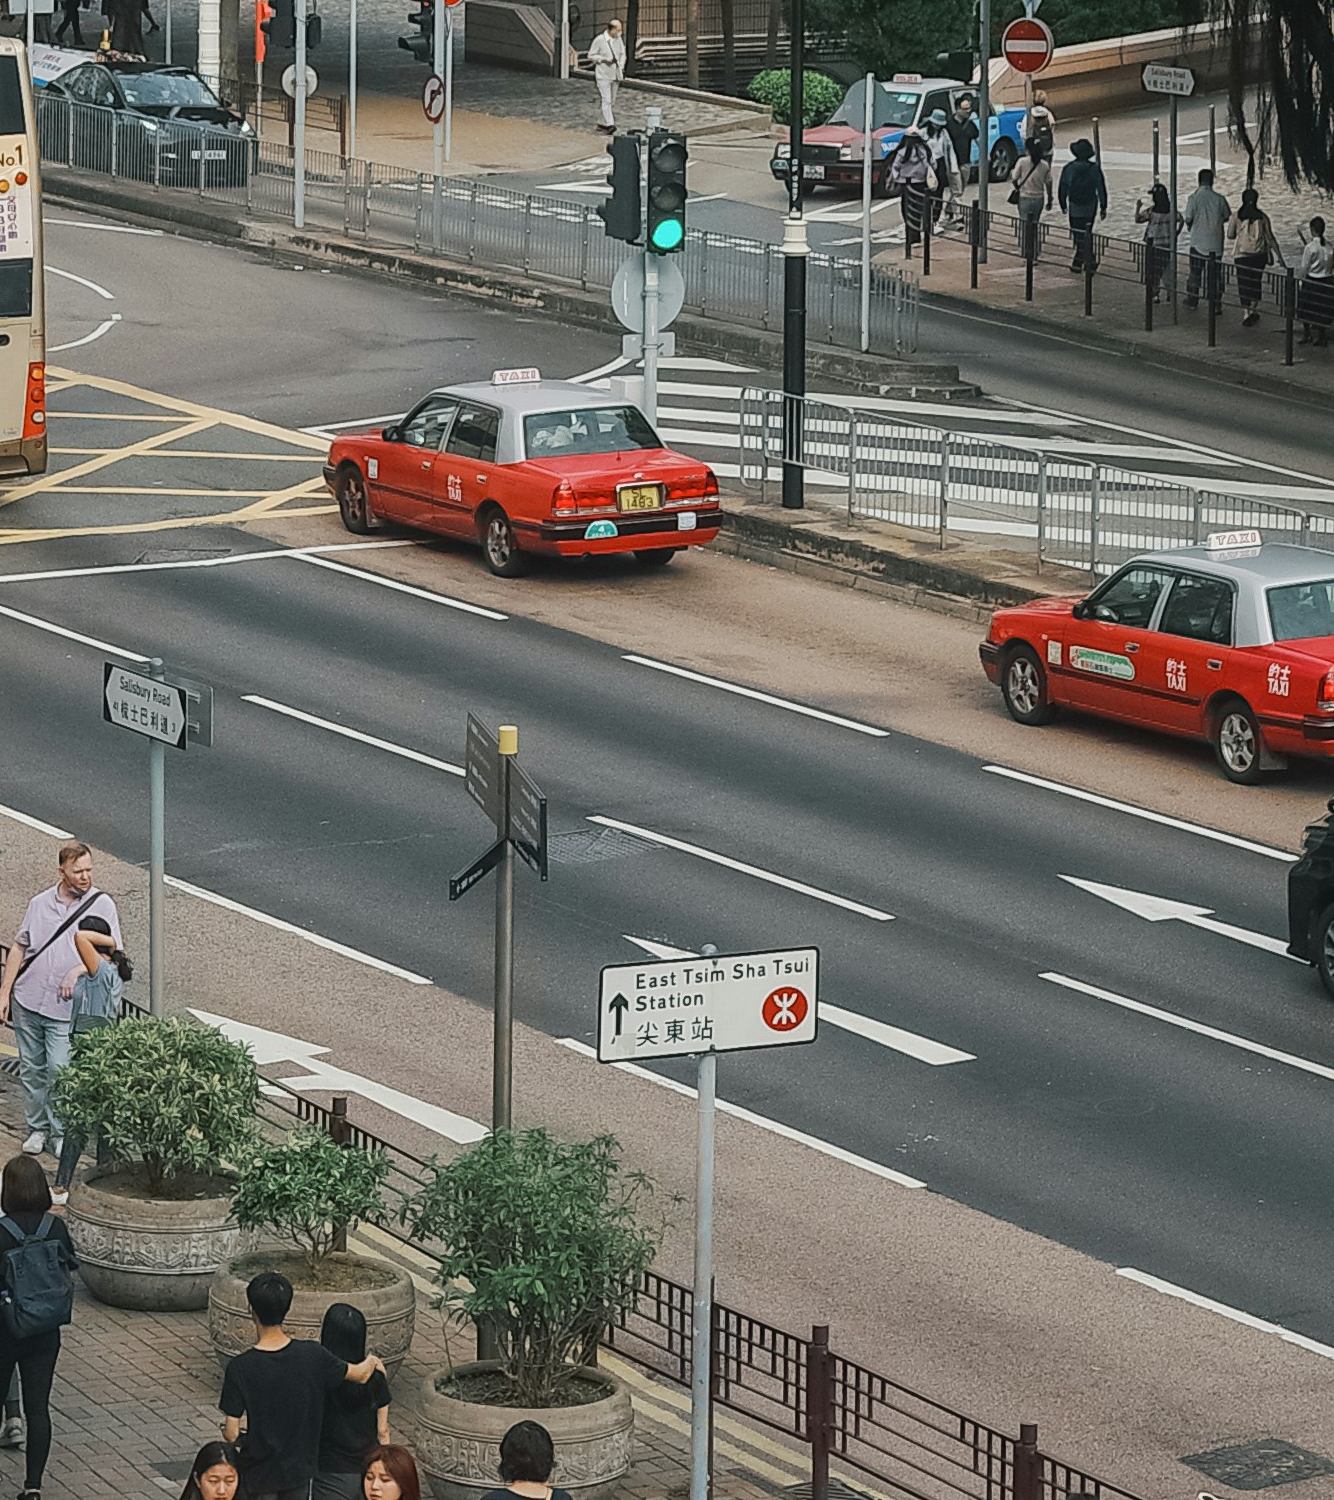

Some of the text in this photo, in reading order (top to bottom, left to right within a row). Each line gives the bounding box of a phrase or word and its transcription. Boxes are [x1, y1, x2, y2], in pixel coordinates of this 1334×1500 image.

[499, 370, 537, 381] TAXI
[1214, 531, 1259, 547] TAXI
[1167, 658, 1187, 676] 的士
[1268, 662, 1291, 681] 的士
[120, 675, 171, 707] Salisbury Road
[1166, 672, 1187, 692] TAXI
[1267, 678, 1290, 697] TAXI
[635, 957, 810, 990] East Tsim Sha Tsui
[635, 992, 704, 1012] Station
[635, 1016, 714, 1047] 尖東站
